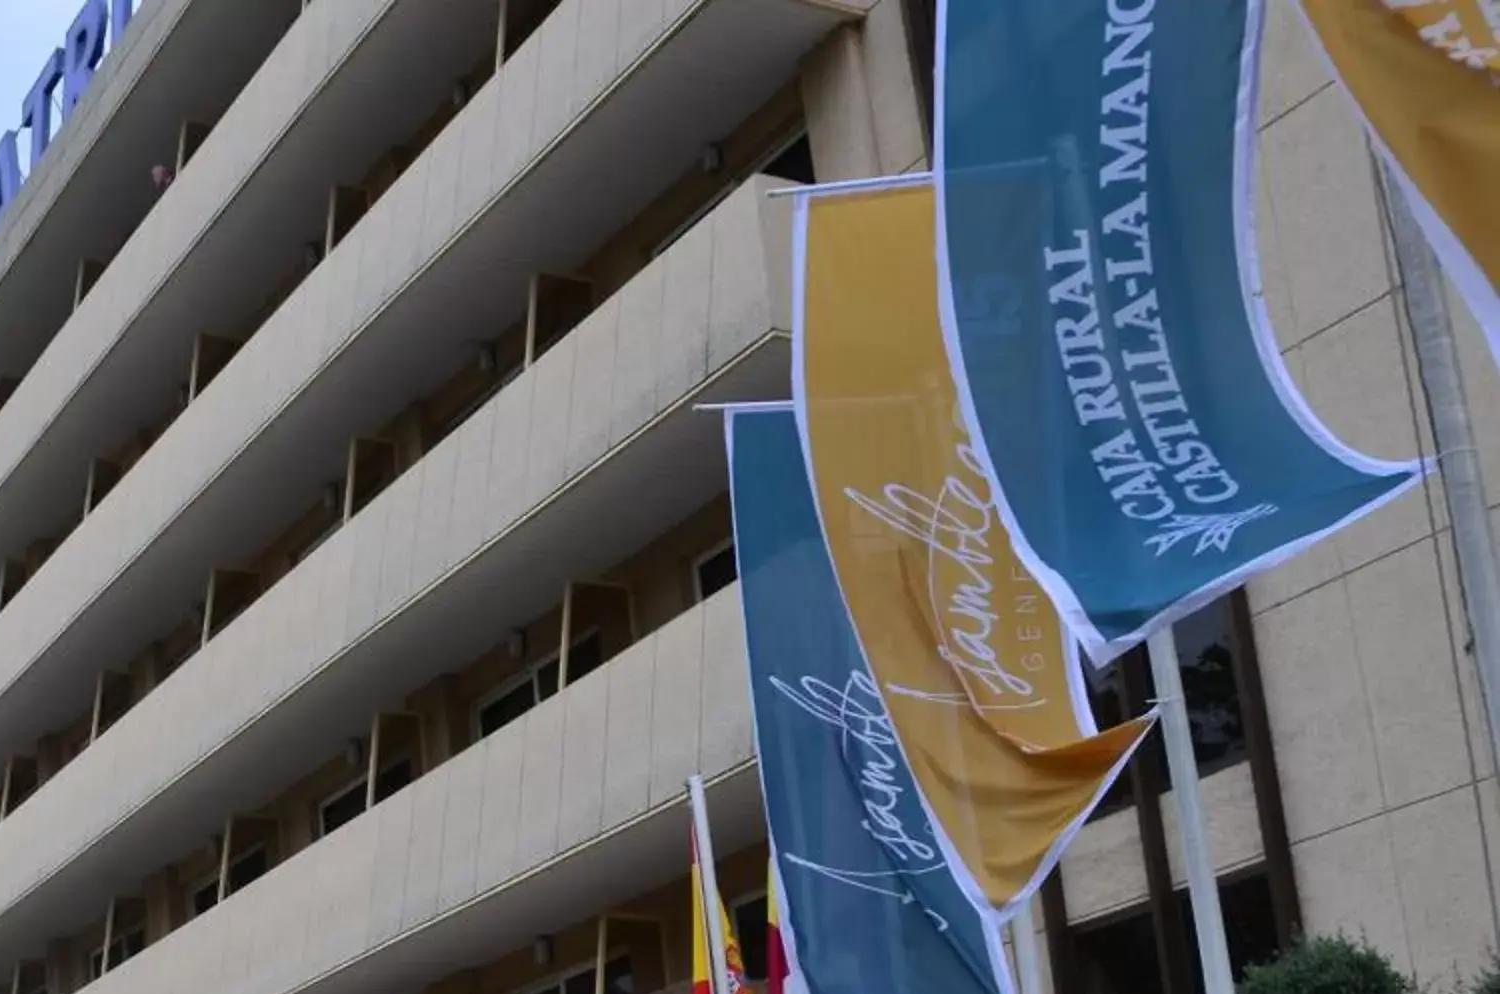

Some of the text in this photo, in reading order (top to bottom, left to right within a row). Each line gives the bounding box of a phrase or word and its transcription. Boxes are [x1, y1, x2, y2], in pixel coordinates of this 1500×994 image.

[1044, 229, 1176, 521] CAJA RURAL
[1102, 191, 1239, 504] CASTILLA-LA
